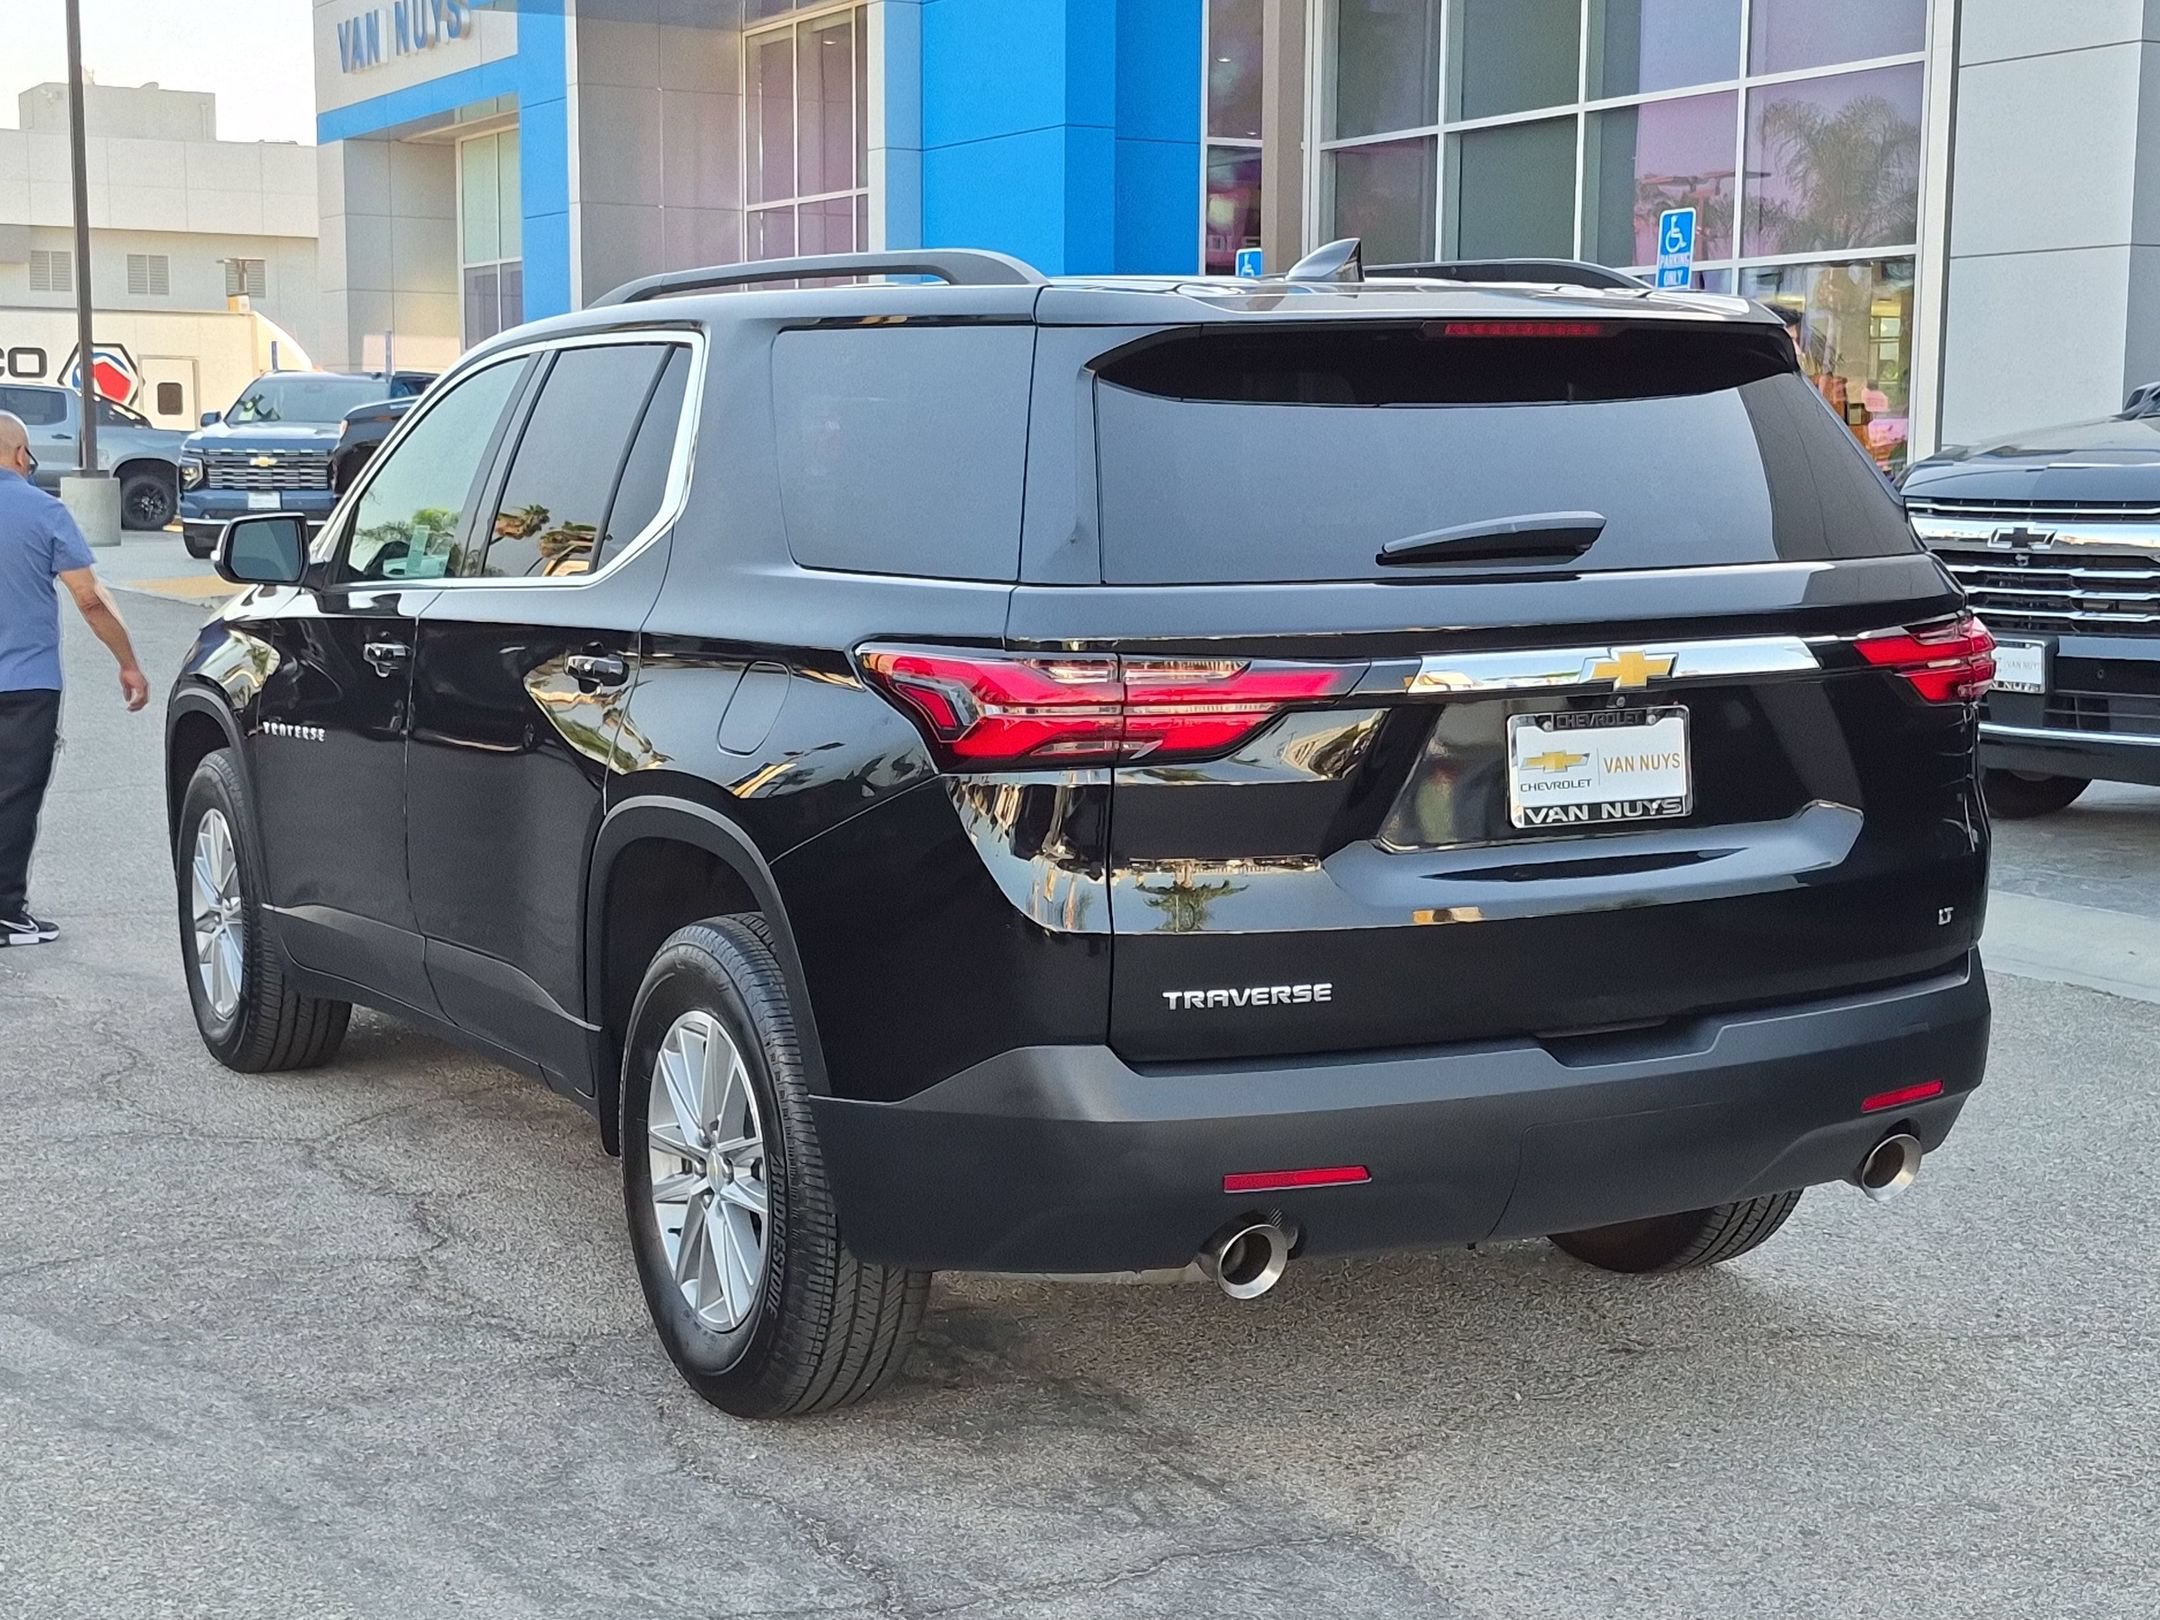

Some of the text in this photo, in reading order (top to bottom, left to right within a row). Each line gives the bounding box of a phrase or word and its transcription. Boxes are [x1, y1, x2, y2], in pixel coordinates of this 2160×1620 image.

[337, 0, 471, 73] VAN NUYS
[1556, 711, 1644, 729] CHEVROLET
[1603, 752, 1681, 774] VAN NUYS
[1520, 778, 1592, 793] CHEVROLET
[1524, 798, 1682, 824] VAN NUYS
[1938, 906, 1954, 925] LT
[1162, 982, 1332, 1010] TRAVERSE
